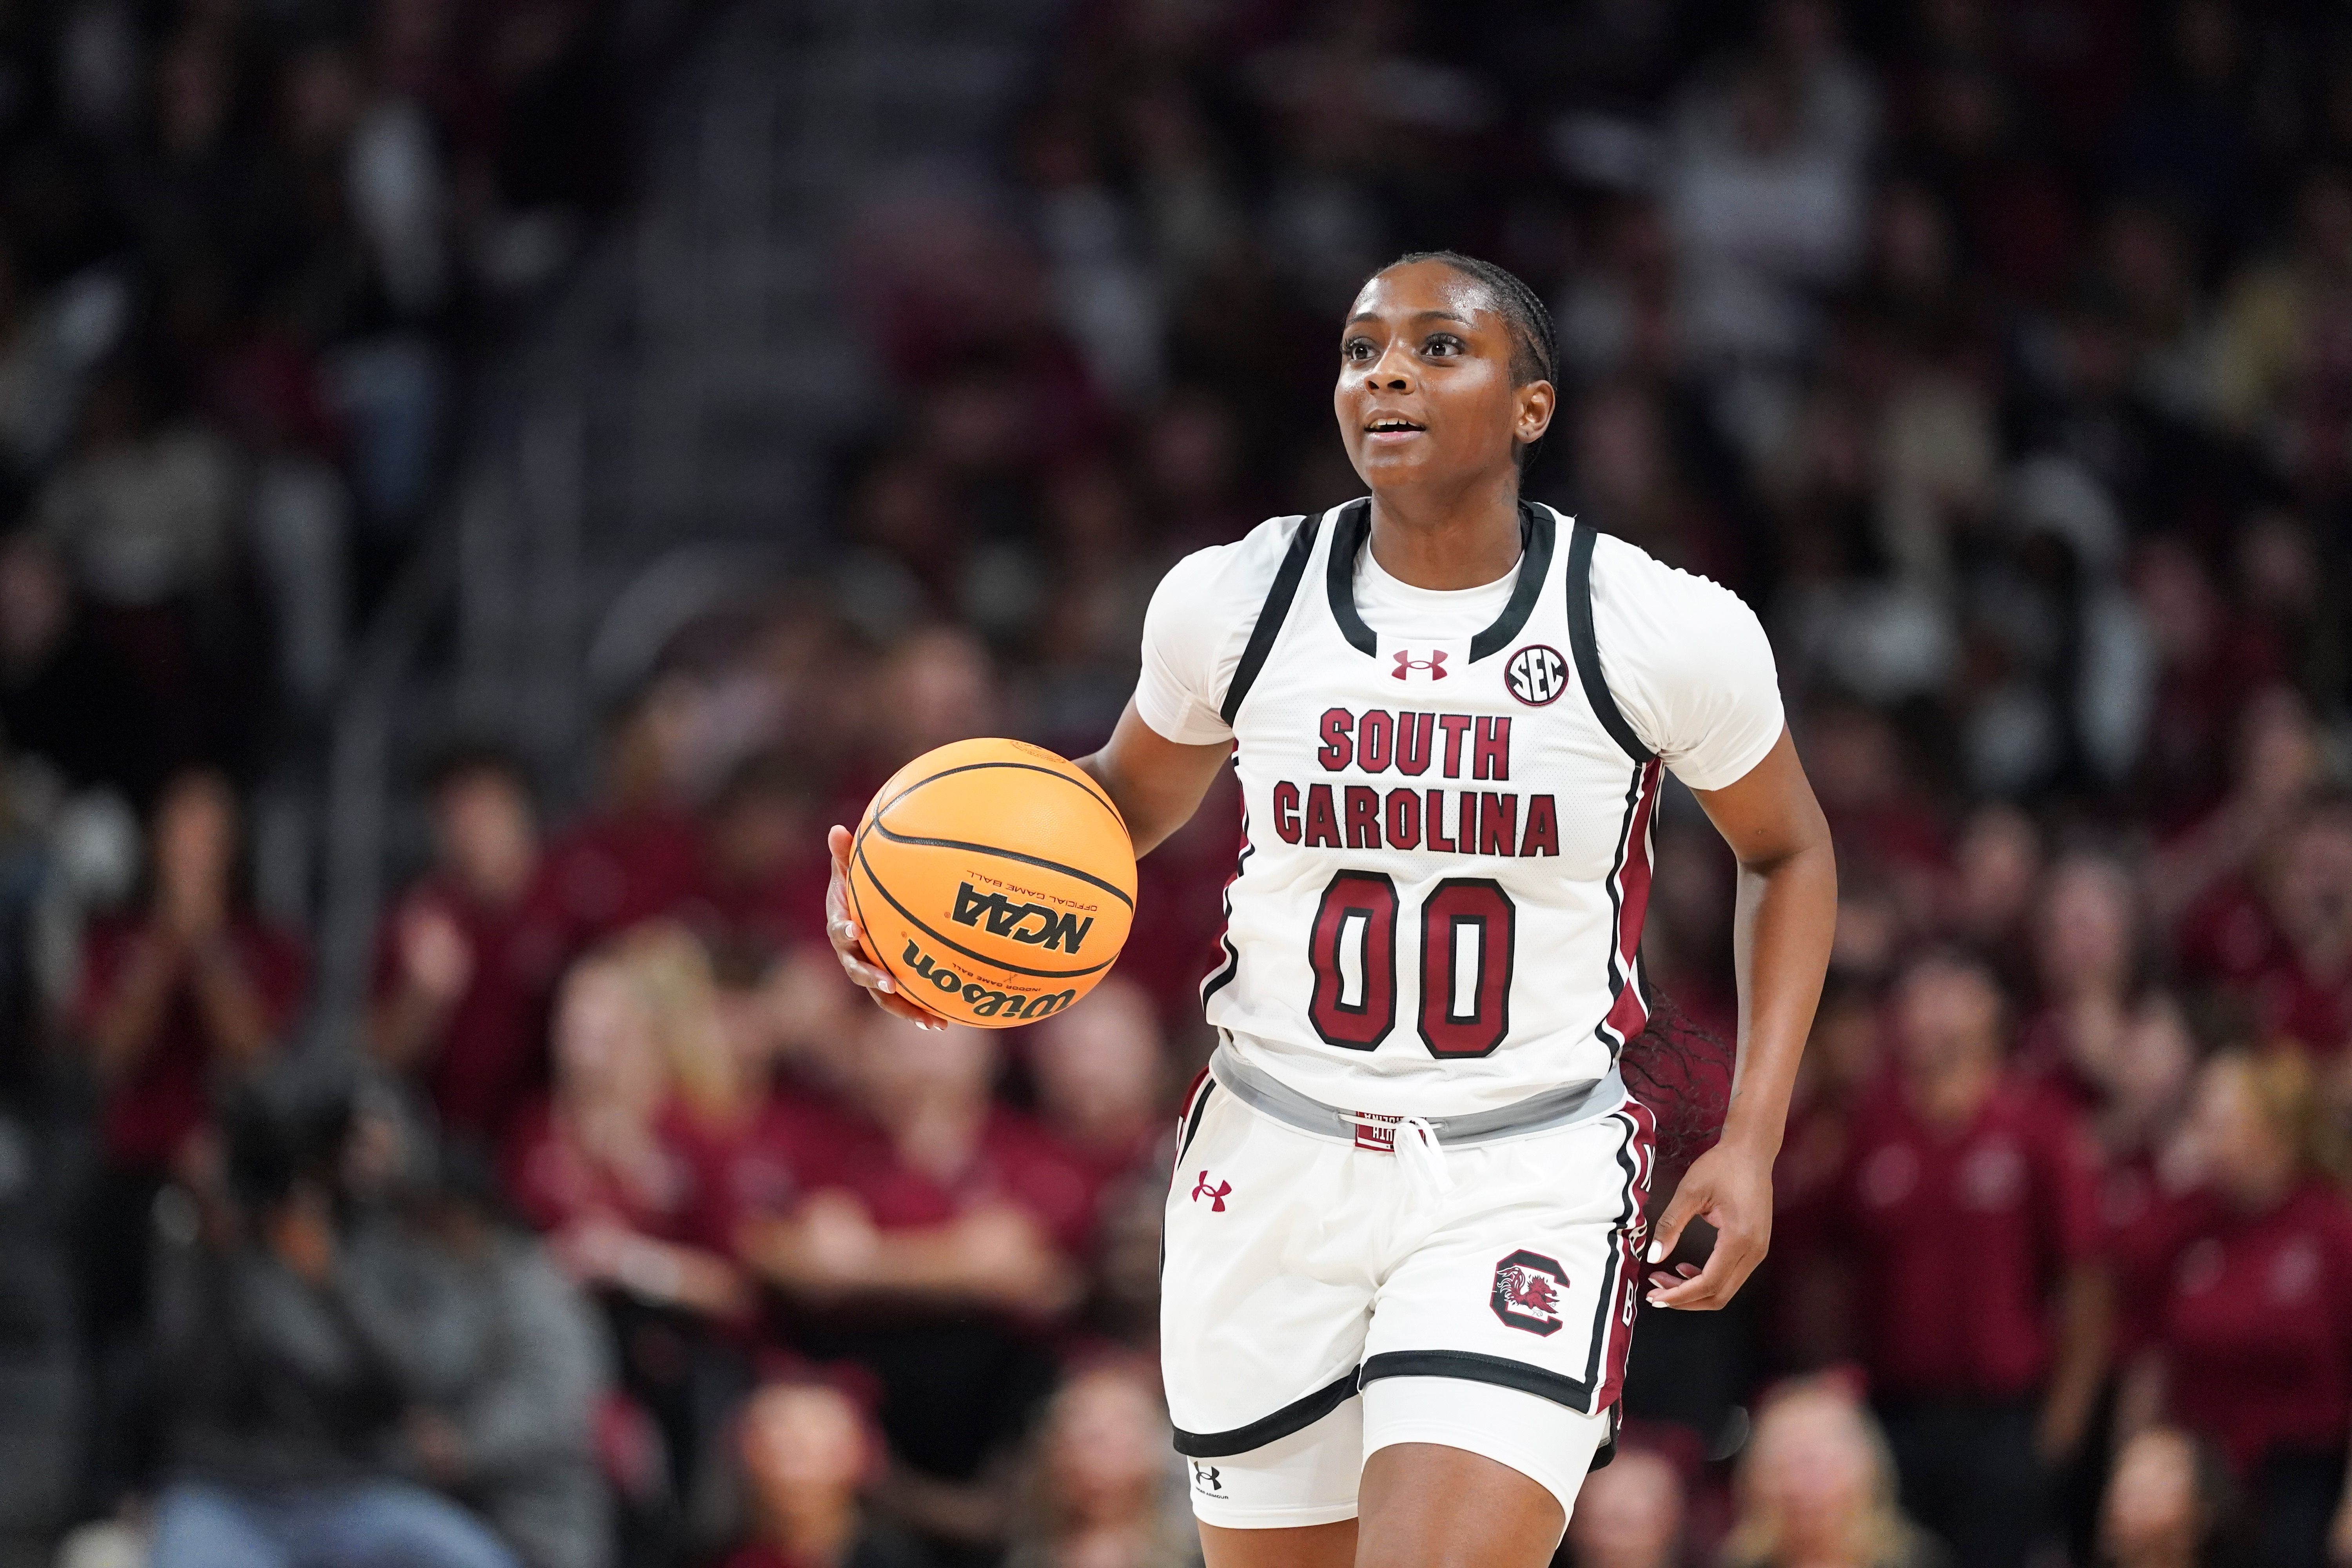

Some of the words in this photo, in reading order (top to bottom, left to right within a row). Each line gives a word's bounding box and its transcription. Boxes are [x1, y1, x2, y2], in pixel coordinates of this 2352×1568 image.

[1510, 648, 1564, 702] SEC
[1318, 708, 1512, 781] SOUTH
[1273, 780, 1560, 858] CAROLINA
[967, 870, 1002, 887] BALL
[1005, 883, 1045, 900] GAME
[952, 881, 1094, 955] NCAA
[1049, 896, 1098, 912] OFFICIAL
[902, 938, 1076, 1019] Wilson
[952, 962, 974, 977] BALL
[976, 975, 1003, 987] GAME
[1308, 869, 1516, 1060] 00
[1372, 1126, 1396, 1142] UTH
